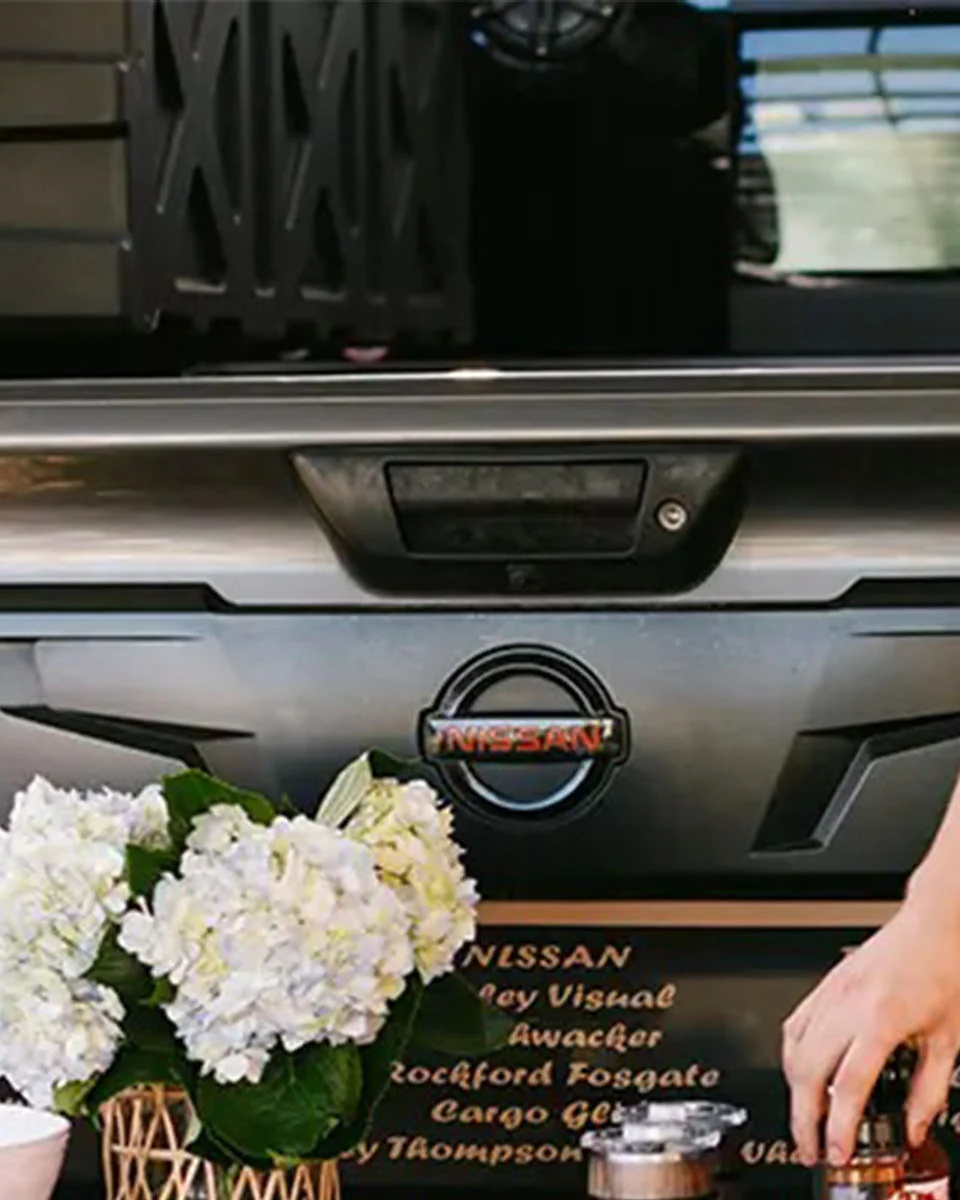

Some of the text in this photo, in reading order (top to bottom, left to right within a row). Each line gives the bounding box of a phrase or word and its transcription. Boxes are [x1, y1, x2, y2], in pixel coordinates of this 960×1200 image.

[437, 724, 602, 752] NISSAN
[462, 944, 633, 969] NISSAN
[548, 983, 677, 1011] Visual
[508, 1022, 664, 1054] hwacker
[566, 1061, 721, 1092] Fosgate
[430, 1098, 550, 1130] Cargo
[387, 1135, 584, 1167] Thompson
